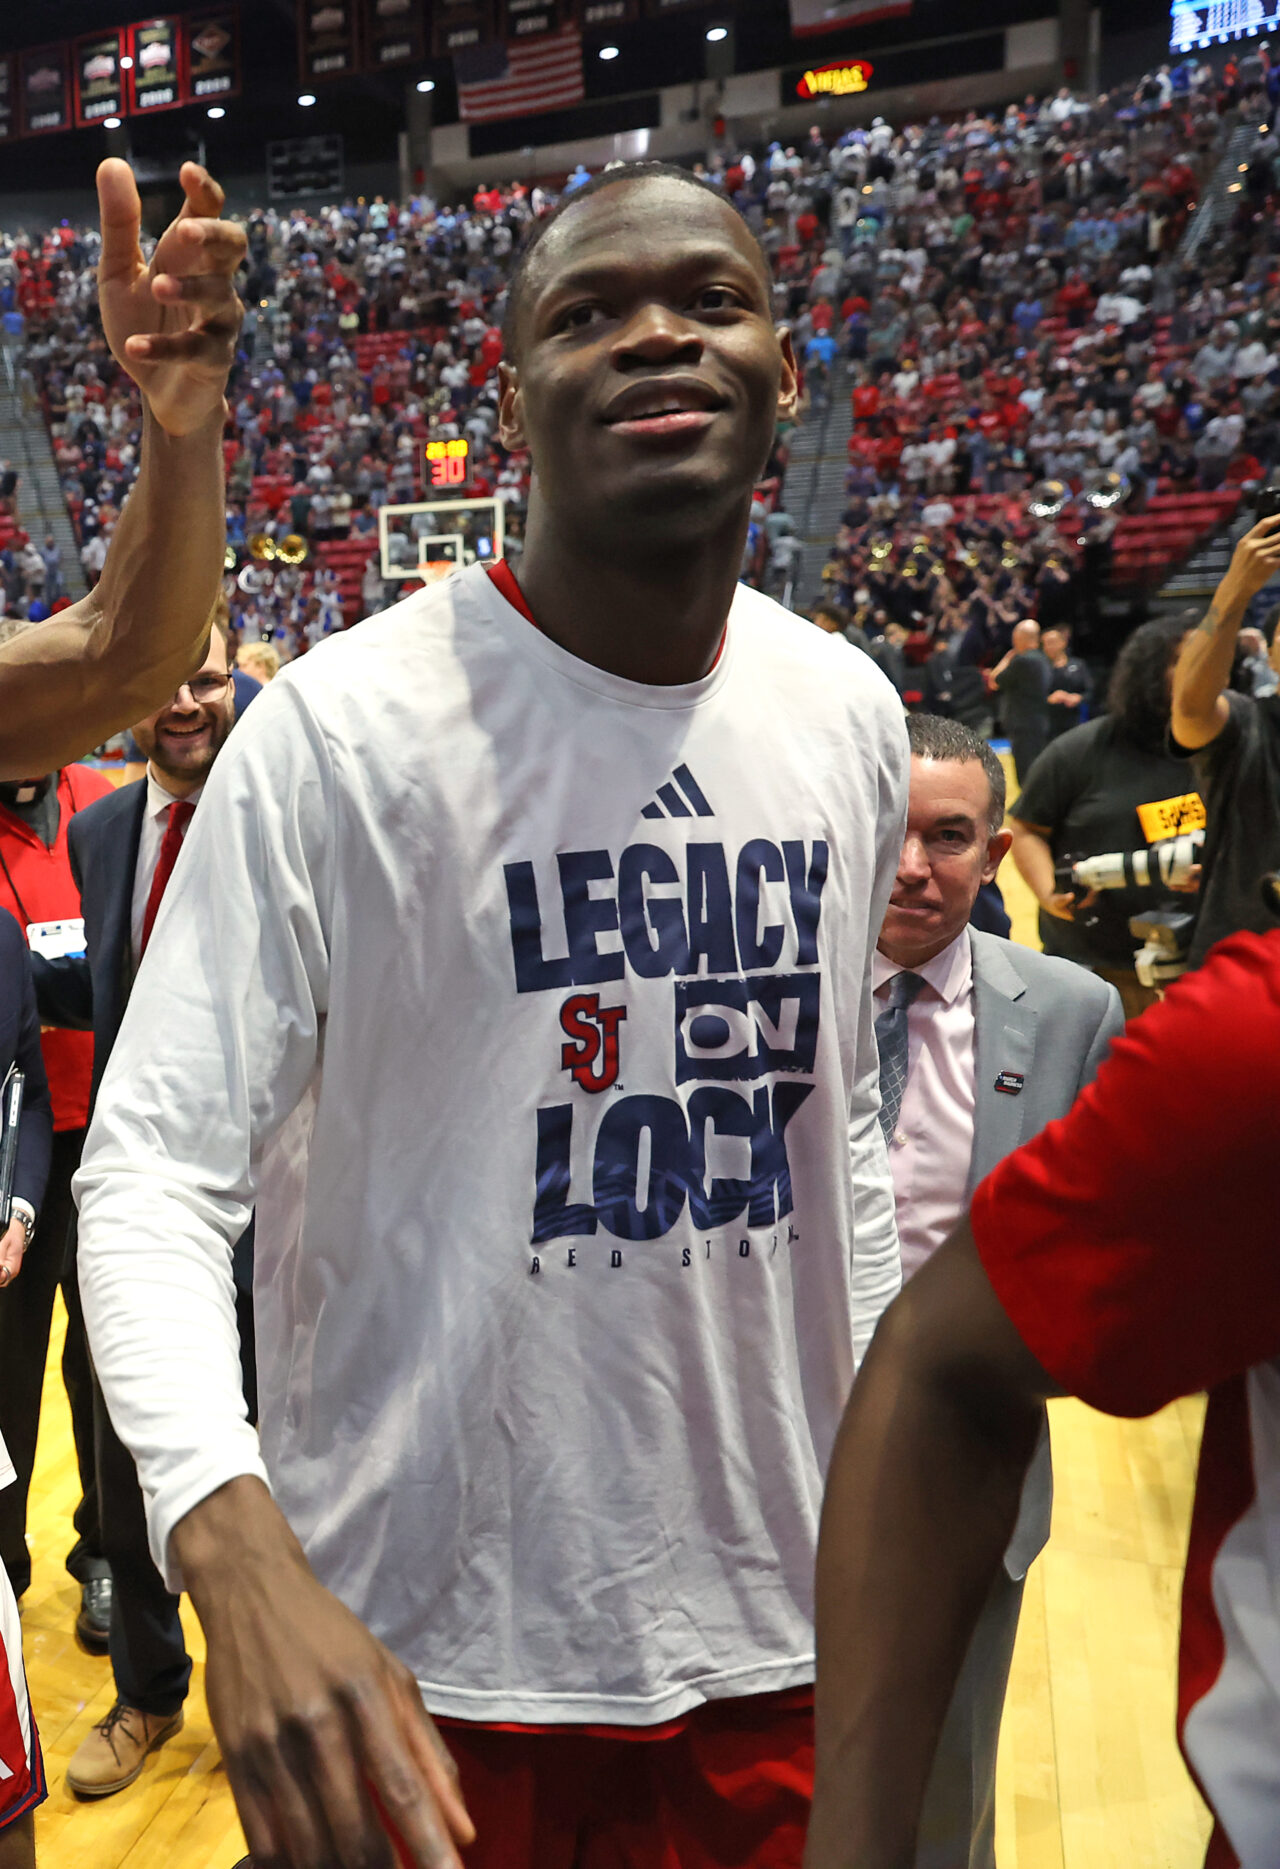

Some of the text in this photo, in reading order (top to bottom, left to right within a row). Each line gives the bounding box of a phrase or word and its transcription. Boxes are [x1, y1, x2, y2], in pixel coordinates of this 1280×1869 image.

[431, 456, 466, 485] 30
[503, 838, 829, 993] LEGACY
[679, 996, 800, 1060] ON
[531, 1081, 815, 1245] LOCK
[681, 1224, 796, 1267] STO
